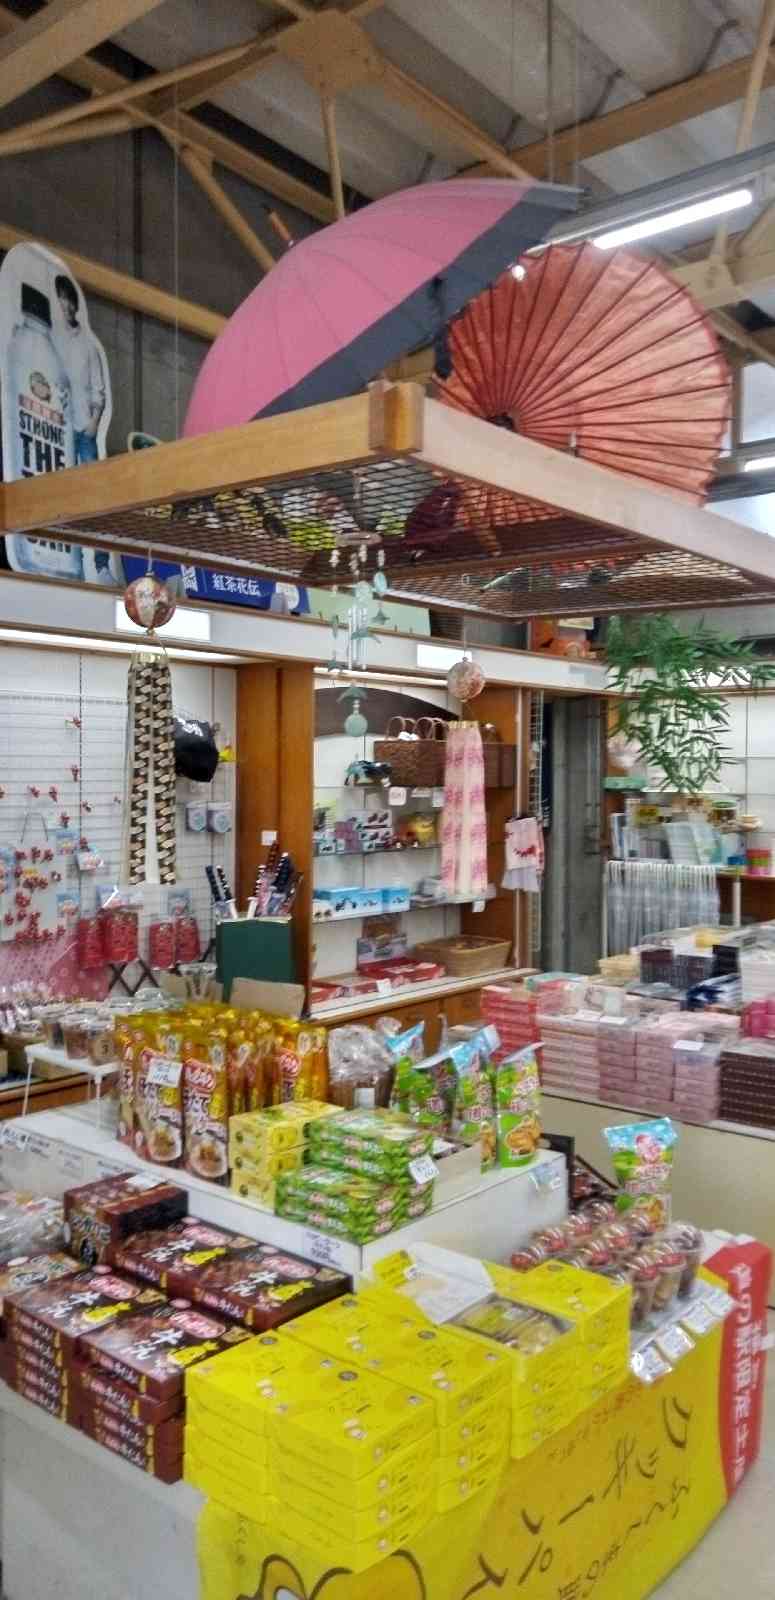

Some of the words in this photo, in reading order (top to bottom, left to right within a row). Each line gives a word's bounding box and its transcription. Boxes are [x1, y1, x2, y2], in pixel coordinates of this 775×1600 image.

[19, 431, 66, 473] THE
[212, 573, 262, 596] 紅茶花伝
